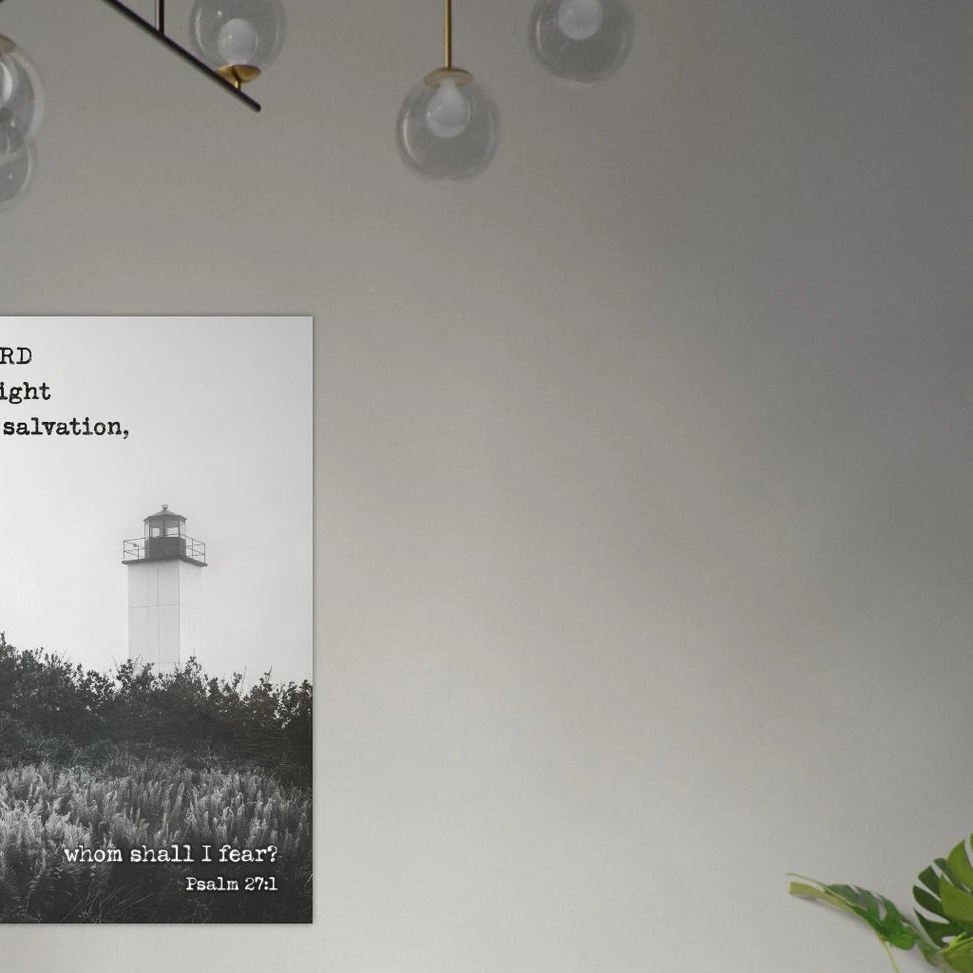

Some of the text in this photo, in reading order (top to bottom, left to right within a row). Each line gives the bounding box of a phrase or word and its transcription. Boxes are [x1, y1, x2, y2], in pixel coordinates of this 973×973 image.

[3, 416, 130, 440] salvation,
[64, 844, 279, 863] whom shall I fear?
[185, 876, 278, 891] Psalm 27:1
